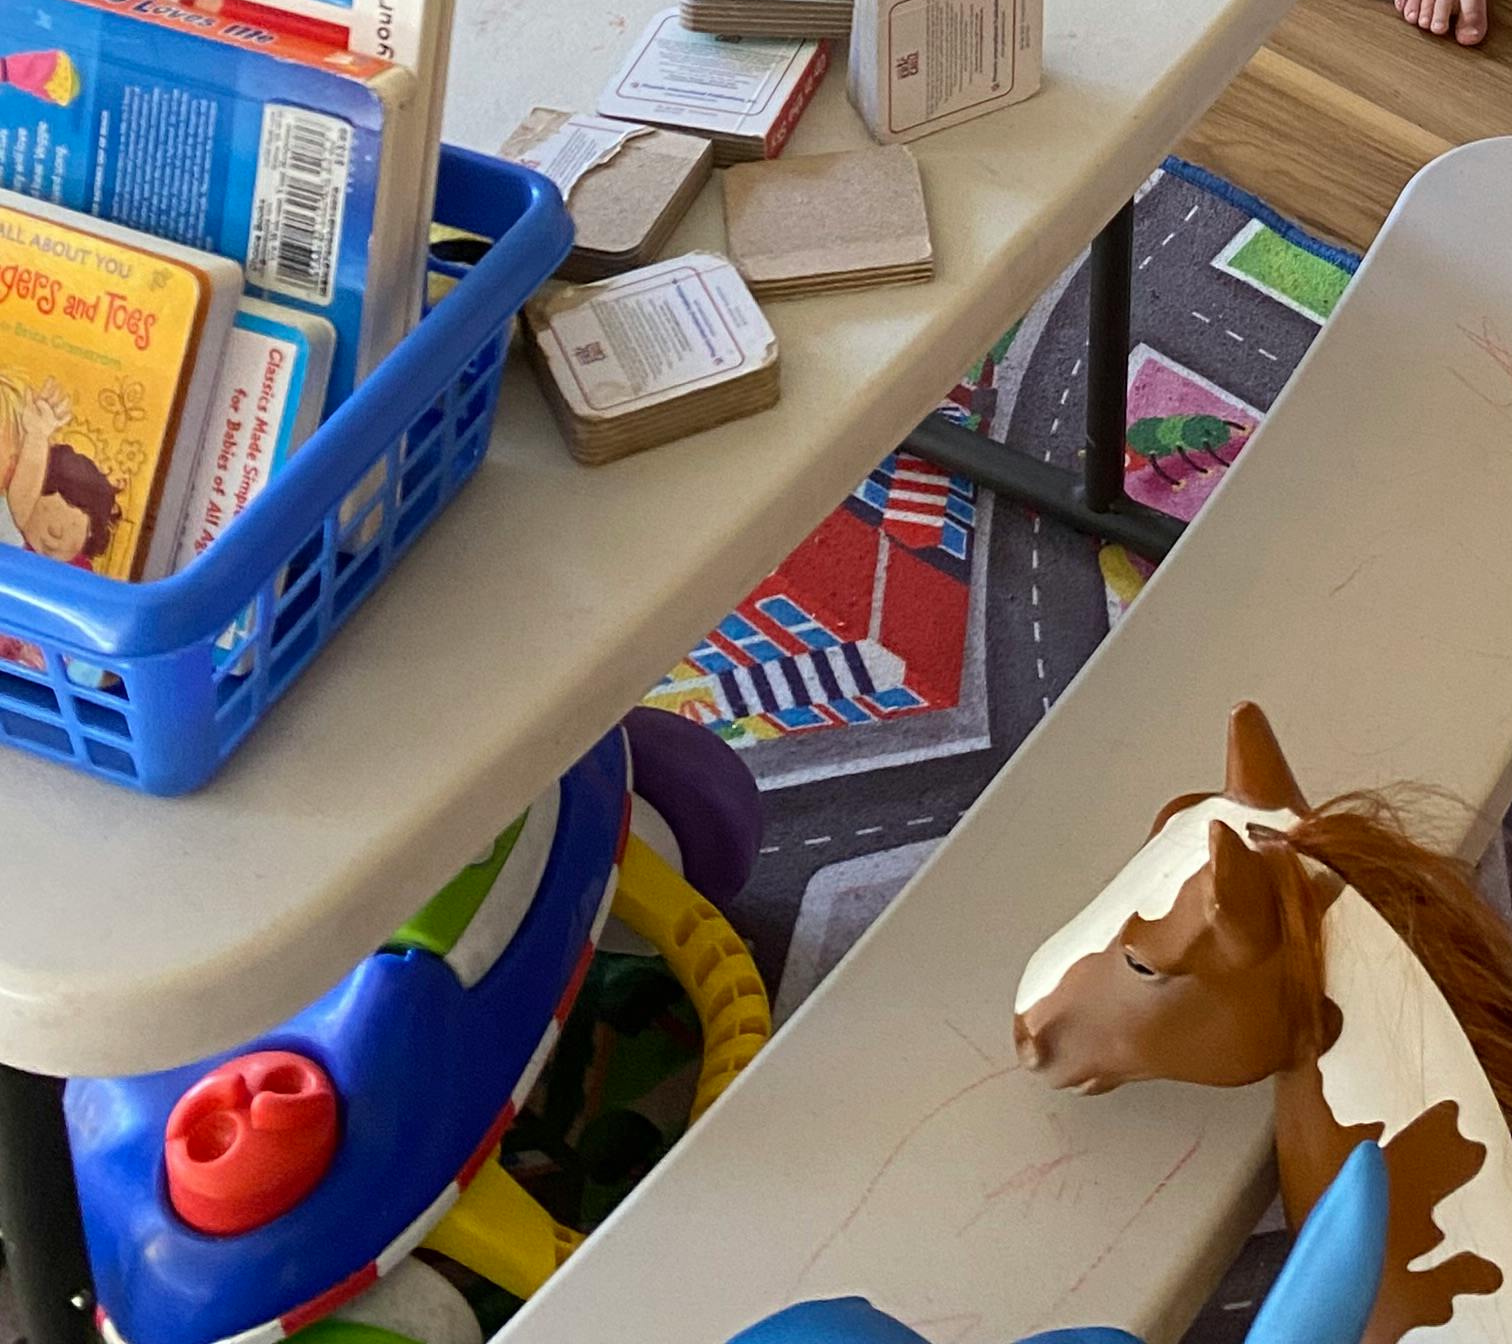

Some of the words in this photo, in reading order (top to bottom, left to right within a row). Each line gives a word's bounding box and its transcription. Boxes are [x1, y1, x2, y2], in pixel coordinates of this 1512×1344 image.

[222, 22, 275, 44] Me
[376, 0, 395, 59] your
[31, 234, 92, 265] ABOUT
[96, 254, 133, 279] YOU
[0, 265, 62, 315] gers
[63, 294, 100, 322] and
[105, 290, 156, 350] Toes
[230, 387, 247, 412] for
[257, 348, 283, 412] Classics
[217, 418, 241, 471] Babies
[247, 415, 268, 460] Made
[212, 476, 225, 496] of
[205, 499, 222, 526] All
